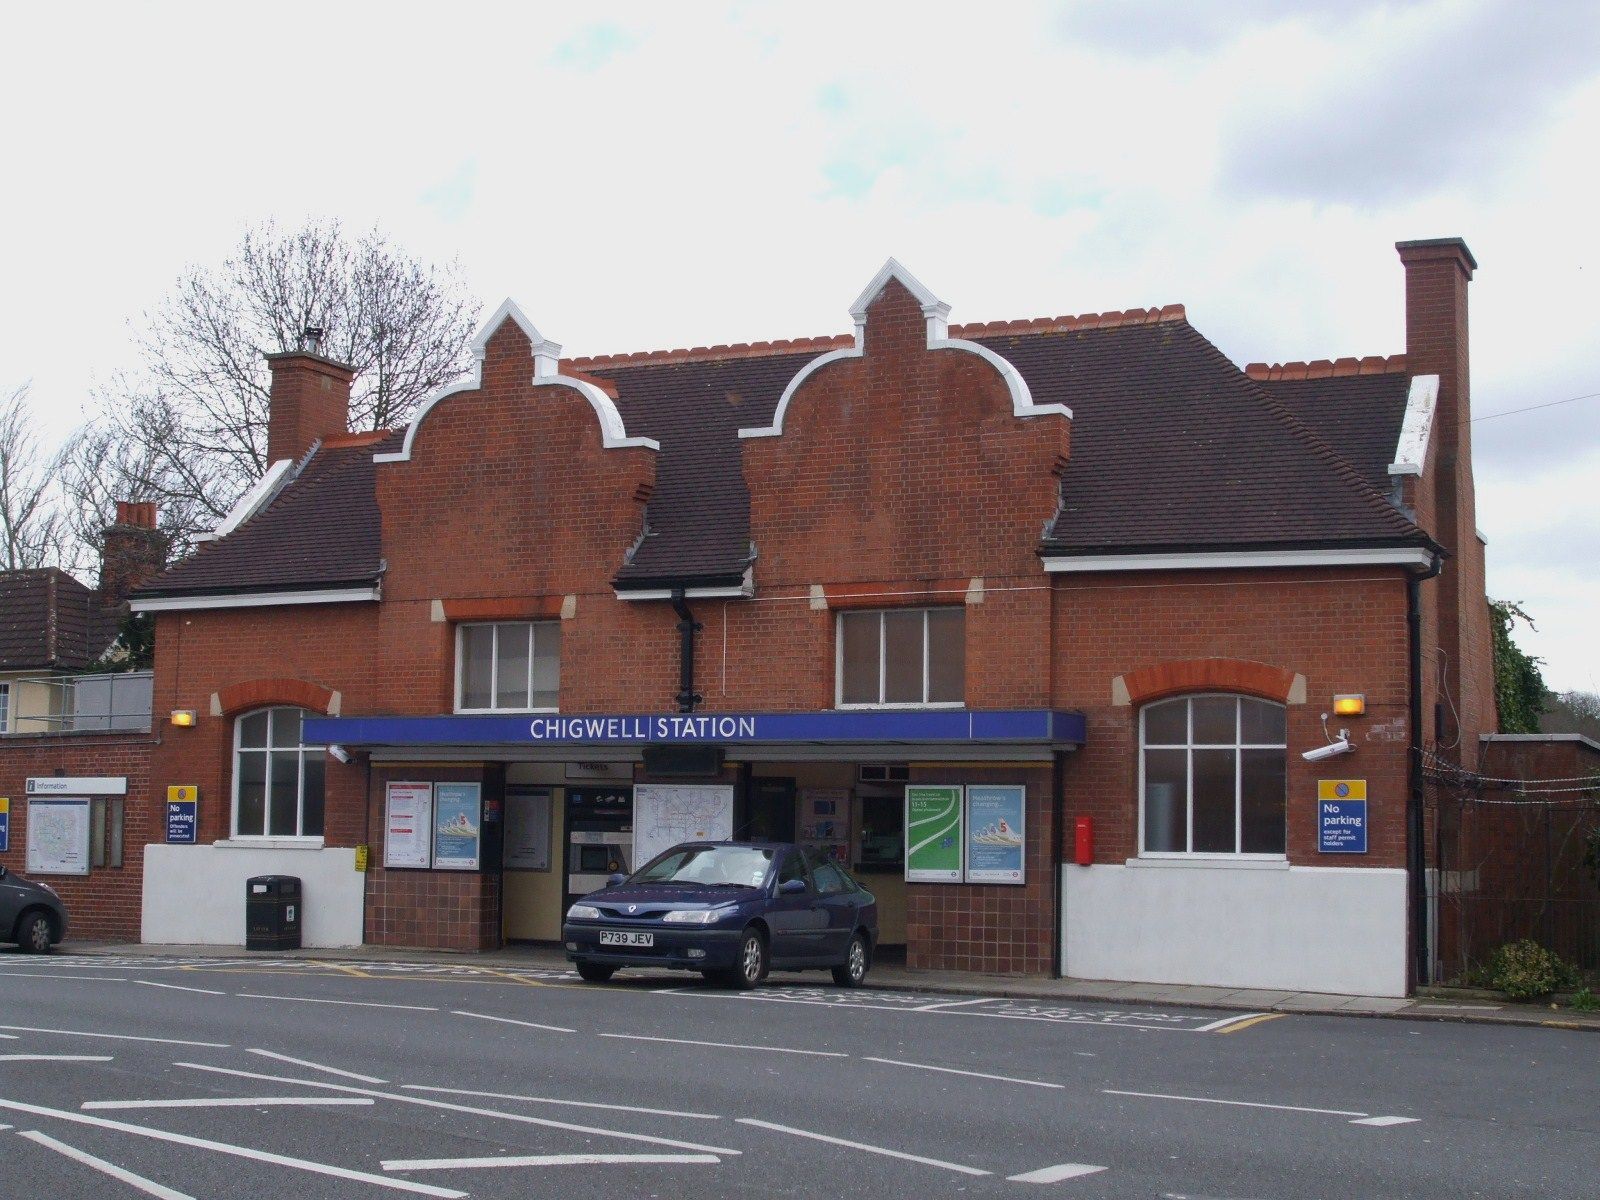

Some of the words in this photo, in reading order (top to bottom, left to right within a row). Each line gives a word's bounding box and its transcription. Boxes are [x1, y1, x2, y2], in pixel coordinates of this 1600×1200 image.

[530, 718, 646, 739] CHIGWELL
[657, 717, 756, 738] STATION
[36, 782, 68, 790] Information
[169, 804, 180, 812] No
[1324, 804, 1340, 813] No
[169, 813, 194, 823] parking
[461, 816, 466, 825] 5
[1324, 816, 1361, 826] parking
[1001, 823, 1007, 833] 5
[600, 931, 629, 944] P739
[630, 933, 652, 945] JEV
